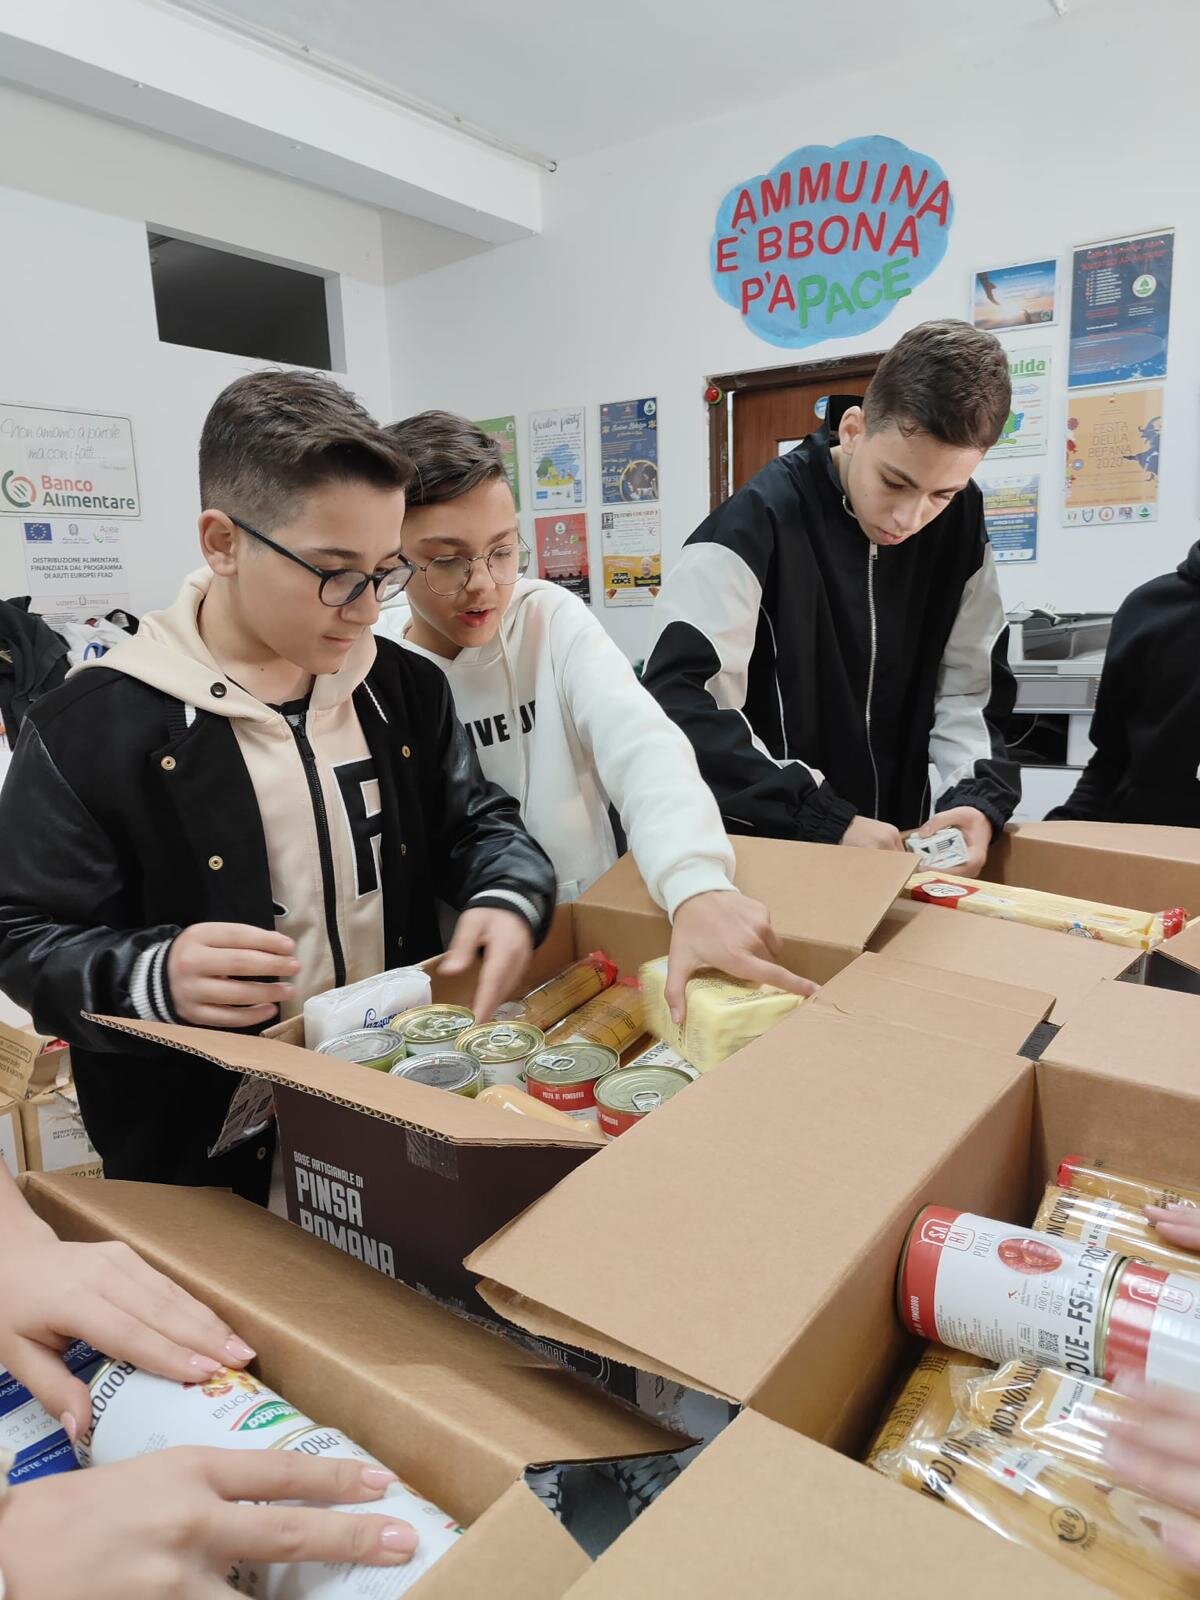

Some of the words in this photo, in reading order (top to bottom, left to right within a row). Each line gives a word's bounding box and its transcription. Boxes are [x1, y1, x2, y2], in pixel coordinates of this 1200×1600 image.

[732, 160, 950, 228] AMMUINA
[757, 209, 919, 263] BBONA
[741, 271, 796, 315] P'A
[797, 256, 912, 329] PACE
[1009, 358, 1045, 375] uida
[1088, 445, 1132, 457] BEFANA
[42, 475, 94, 492] Banco
[42, 491, 136, 510] Alimentare
[293, 1151, 311, 1168] BASE
[311, 1158, 356, 1186] ARTIGIANALE
[355, 1174, 364, 1189] DI
[295, 1166, 364, 1228] PINSA
[928, 1223, 949, 1239] SA
[972, 1231, 996, 1258] POLPA
[1079, 1247, 1112, 1273] PRO
[1067, 1280, 1098, 1324] FSE+
[1065, 1334, 1091, 1361] UE
[78, 1360, 137, 1449] RODOTTO
[11, 1460, 42, 1478] LATTE
[43, 1445, 73, 1464] PARZI
